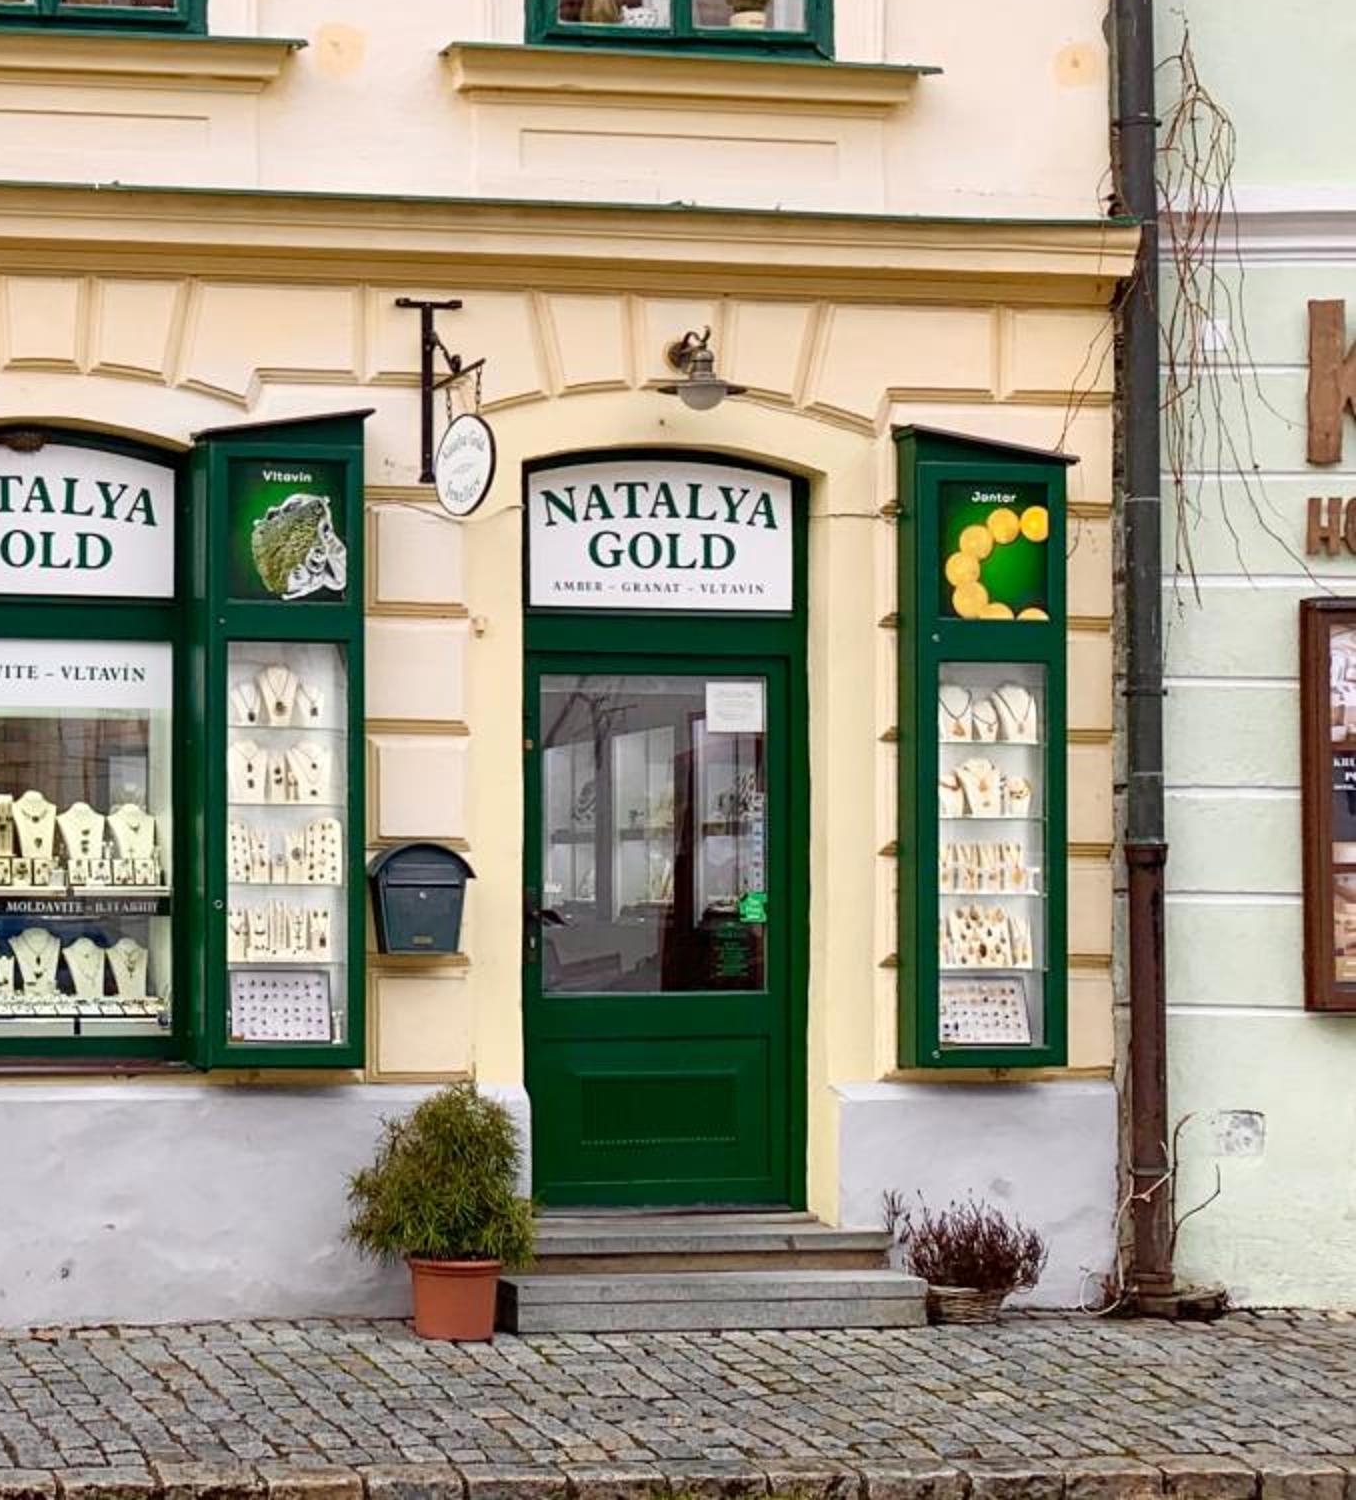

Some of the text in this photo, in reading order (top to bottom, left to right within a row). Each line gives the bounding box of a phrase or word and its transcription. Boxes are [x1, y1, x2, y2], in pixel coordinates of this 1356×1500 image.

[540, 482, 778, 530] NATALYA
[588, 530, 736, 569] GOLD
[554, 580, 603, 592] AMBER
[621, 582, 680, 593] GRANAT
[60, 663, 145, 681] VLTAVÍN
[6, 901, 84, 913] MOLDAVITE
